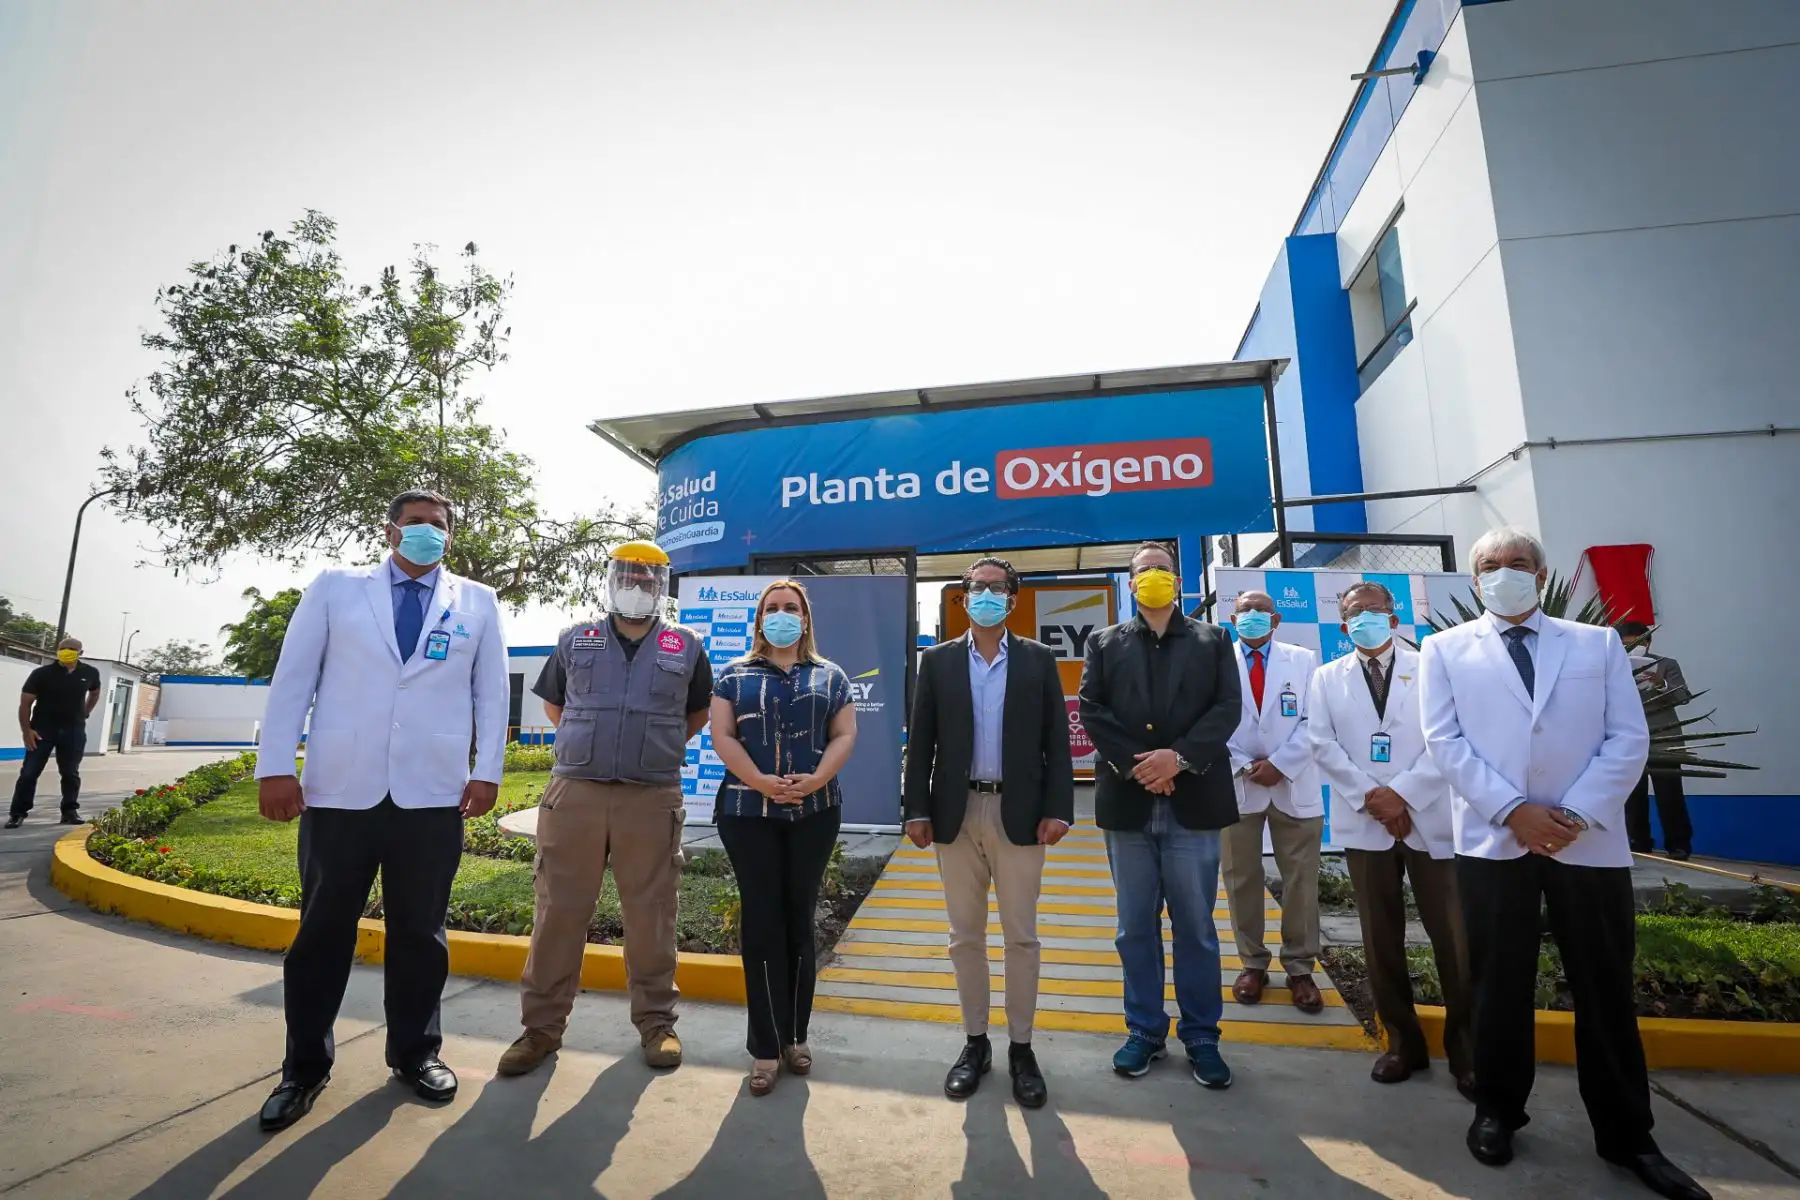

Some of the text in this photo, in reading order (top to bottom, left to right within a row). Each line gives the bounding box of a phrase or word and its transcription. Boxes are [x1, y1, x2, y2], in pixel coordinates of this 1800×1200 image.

[782, 450, 1203, 508] Planta de Oxígeno
[670, 497, 719, 525] Cuida
[1276, 600, 1308, 608] EsSalud
[1040, 624, 1095, 658] EY
[850, 683, 874, 700] EY
